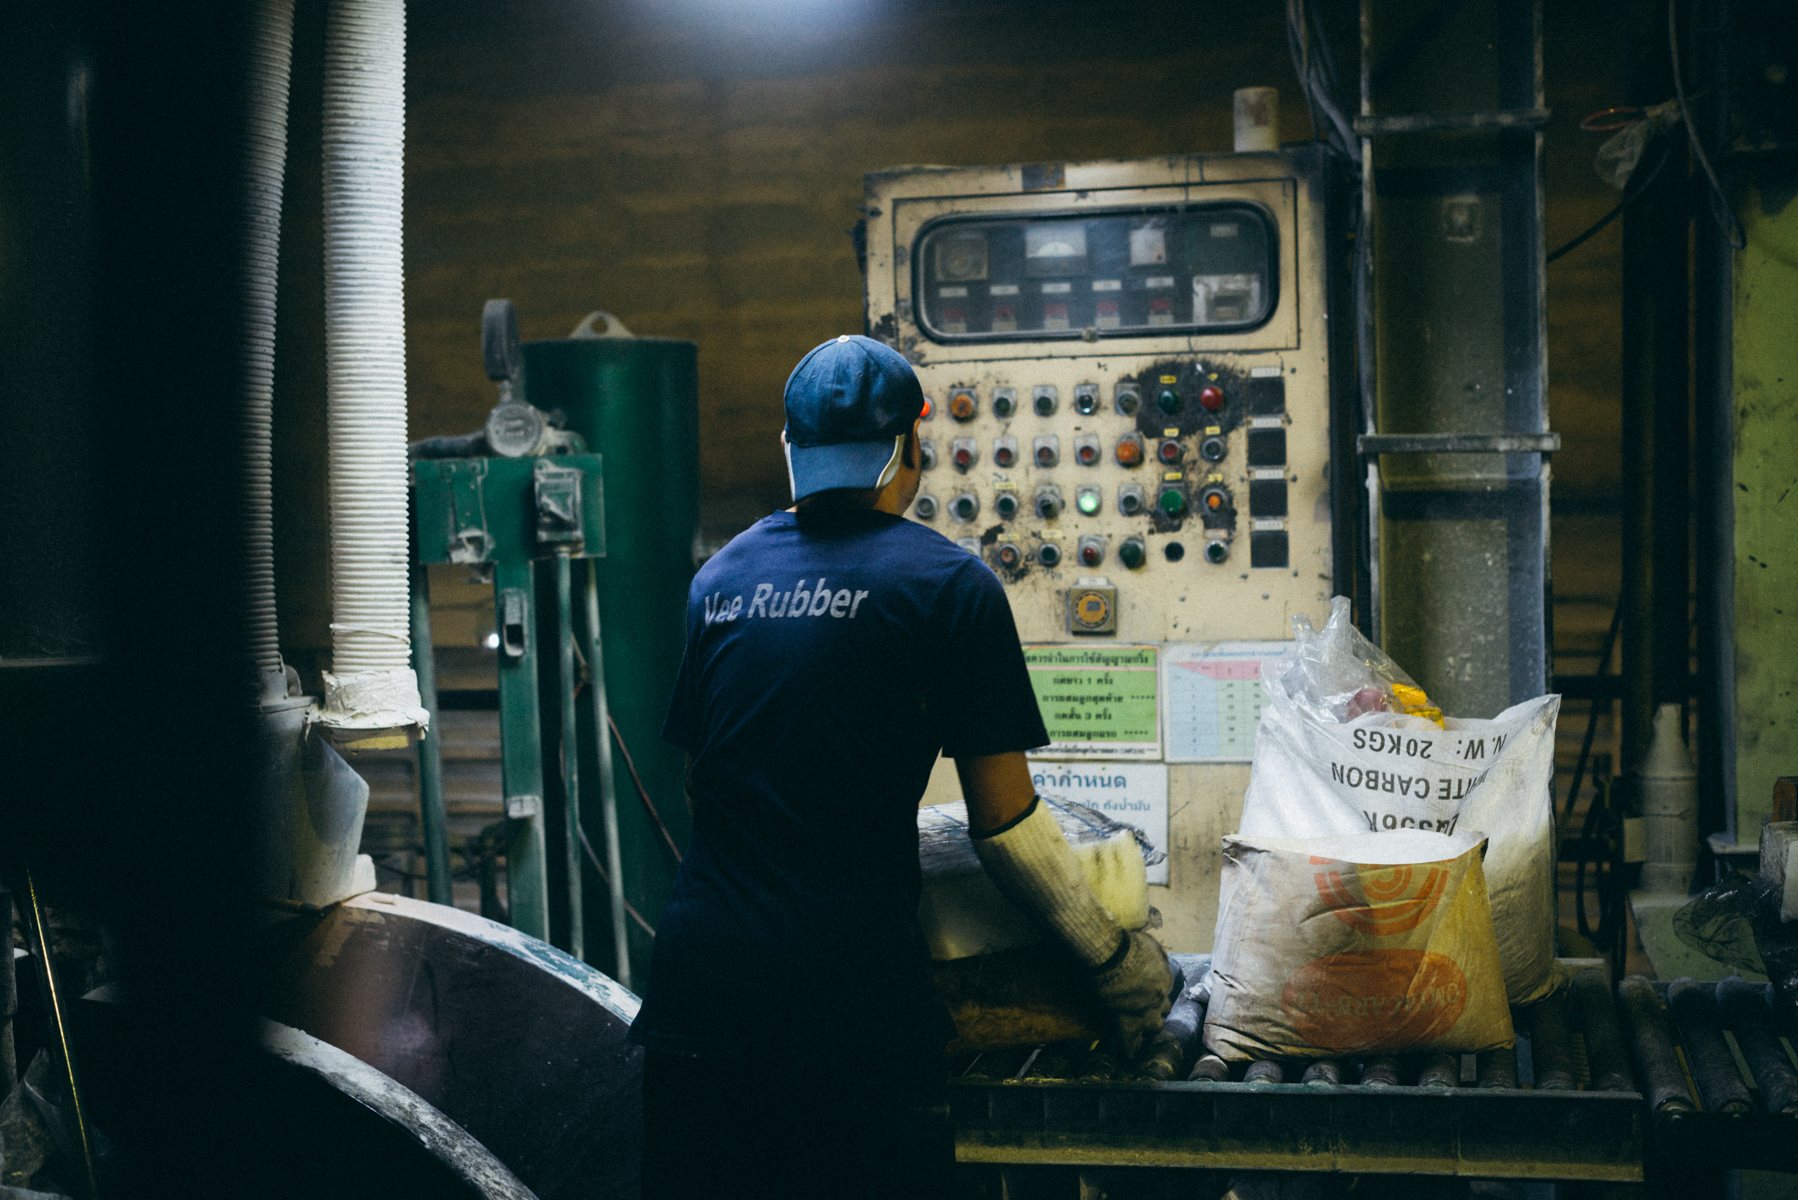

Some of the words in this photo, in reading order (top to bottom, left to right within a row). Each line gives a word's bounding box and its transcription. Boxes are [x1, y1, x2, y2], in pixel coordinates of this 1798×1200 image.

[704, 592, 743, 626] Vee
[748, 577, 869, 619] Rubber
[1032, 769, 1128, 789] ค่ากำหนด
[1331, 761, 1431, 800] CARBON
